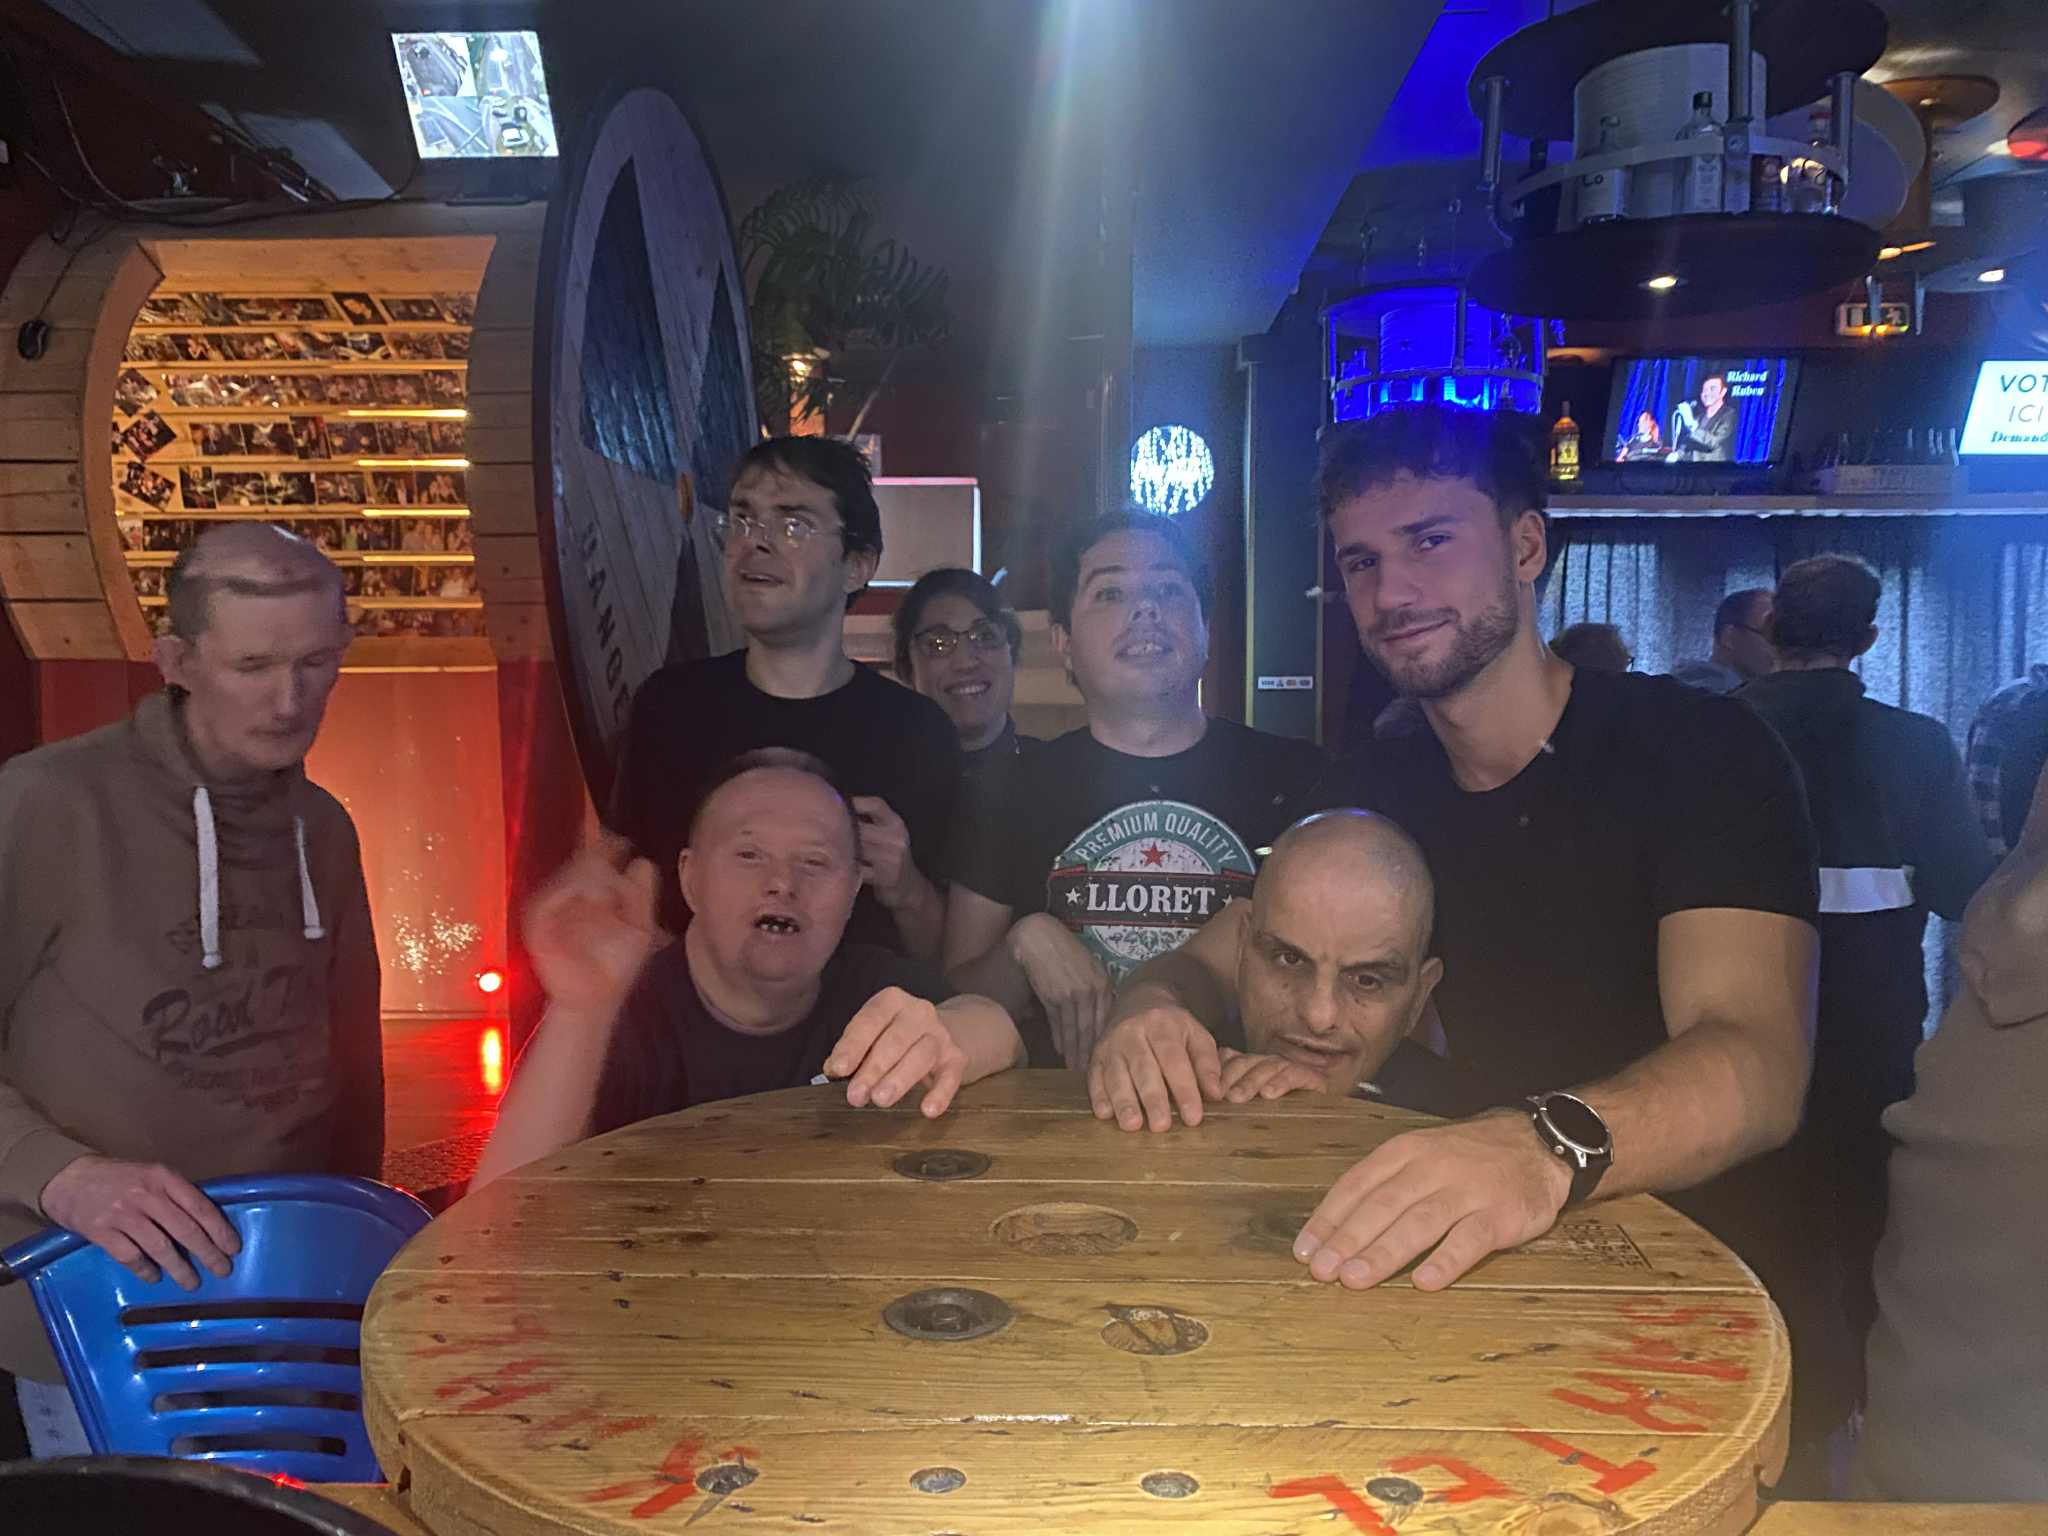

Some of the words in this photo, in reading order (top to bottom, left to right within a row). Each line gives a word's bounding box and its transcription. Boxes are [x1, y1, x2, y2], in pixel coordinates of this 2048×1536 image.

[1727, 370, 1768, 382] Richard
[2008, 404, 2044, 422] ICI
[1075, 812, 1158, 861] PREMIUM
[1165, 813, 1238, 863] QUALITY
[1086, 883, 1216, 914] LLORET
